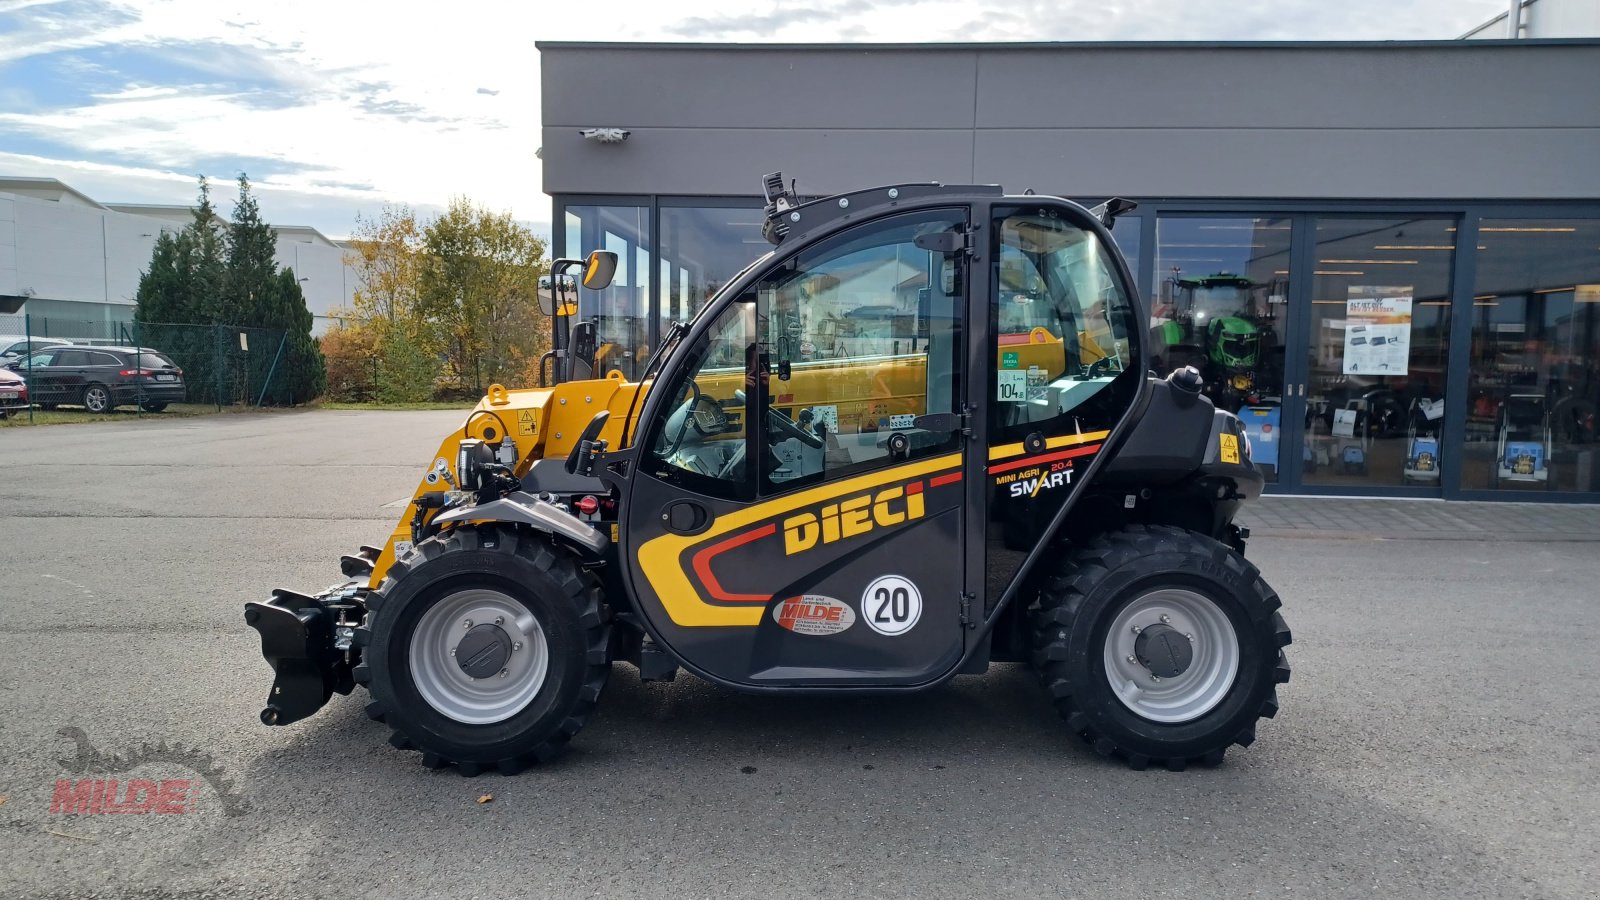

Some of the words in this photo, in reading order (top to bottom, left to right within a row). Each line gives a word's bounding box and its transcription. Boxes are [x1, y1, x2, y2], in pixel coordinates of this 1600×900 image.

[1000, 384, 1018, 398] 104
[1051, 460, 1073, 472] 20.4
[996, 473, 1016, 485] MINI
[1018, 467, 1040, 480] AGRI
[1010, 469, 1074, 498] SMART
[780, 604, 843, 622] MILDE
[875, 587, 909, 623] 20
